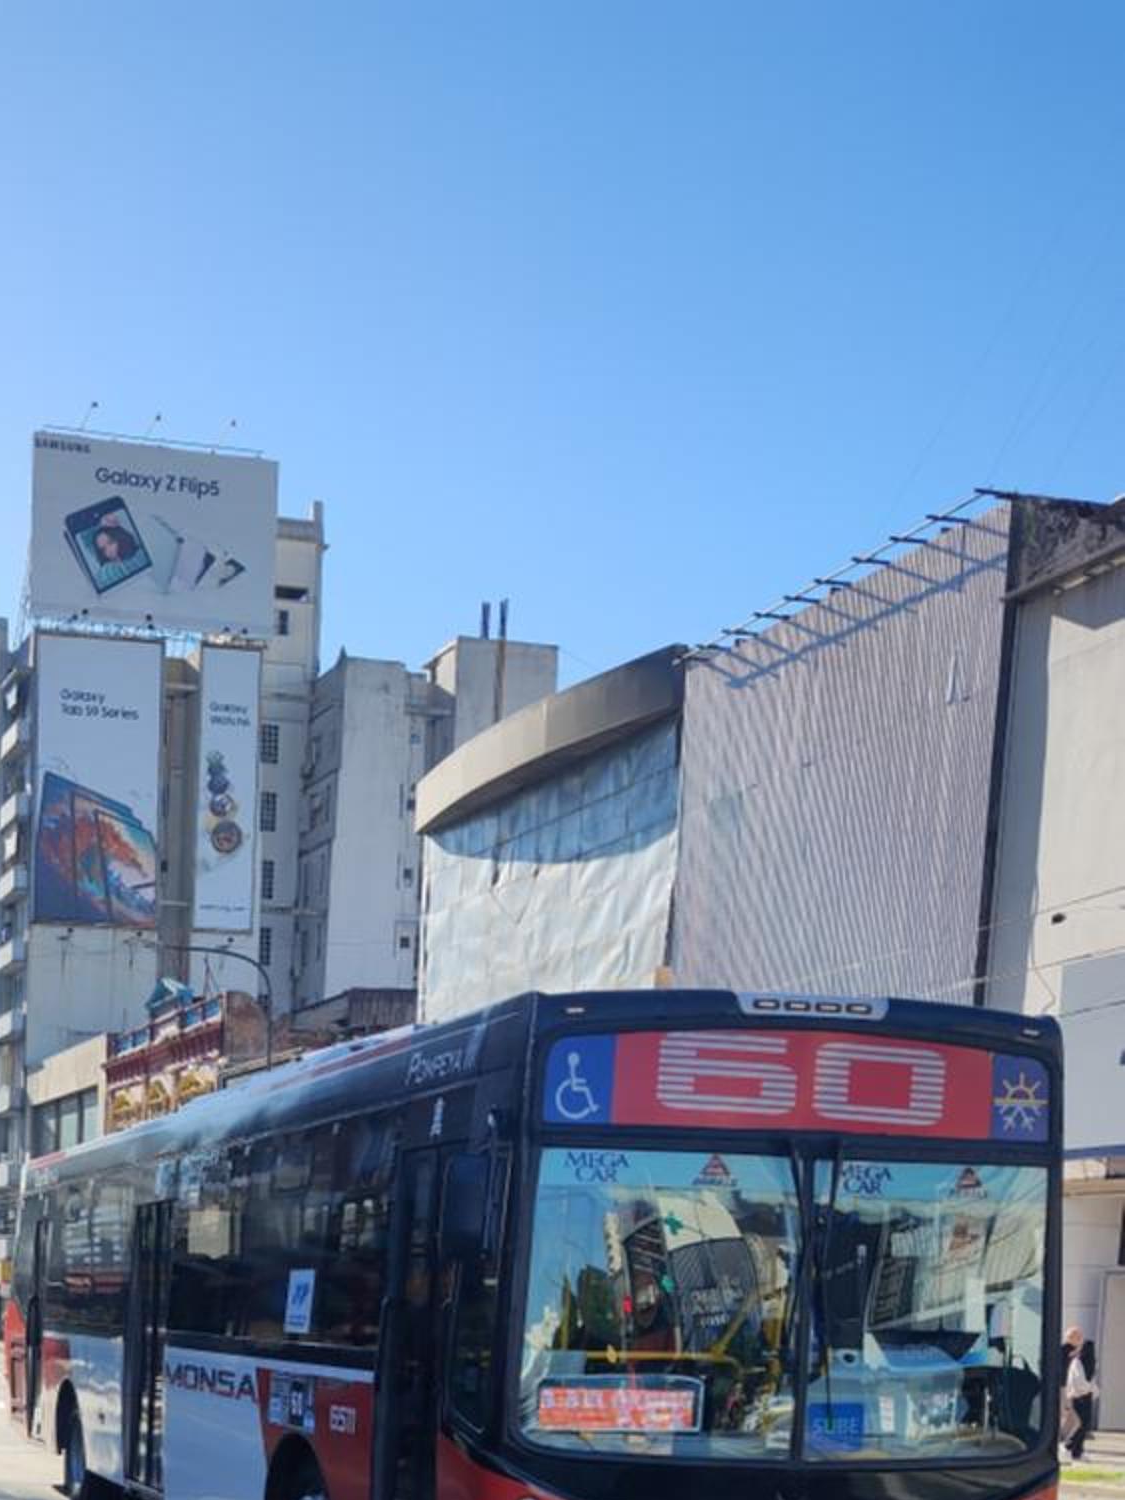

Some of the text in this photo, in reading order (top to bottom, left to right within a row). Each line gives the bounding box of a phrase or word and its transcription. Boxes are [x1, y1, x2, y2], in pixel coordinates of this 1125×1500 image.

[34, 437, 91, 453] SAMSUNG
[95, 467, 220, 499] Galaxy Z Flip5
[59, 688, 106, 704] Galaxy
[61, 703, 82, 717] Tab
[101, 706, 140, 720] Series
[656, 1031, 946, 1126] 60
[564, 1151, 630, 1168] MEGA
[575, 1168, 618, 1183] CAR
[843, 1178, 883, 1195] CAR
[164, 1362, 257, 1402] MONSA
